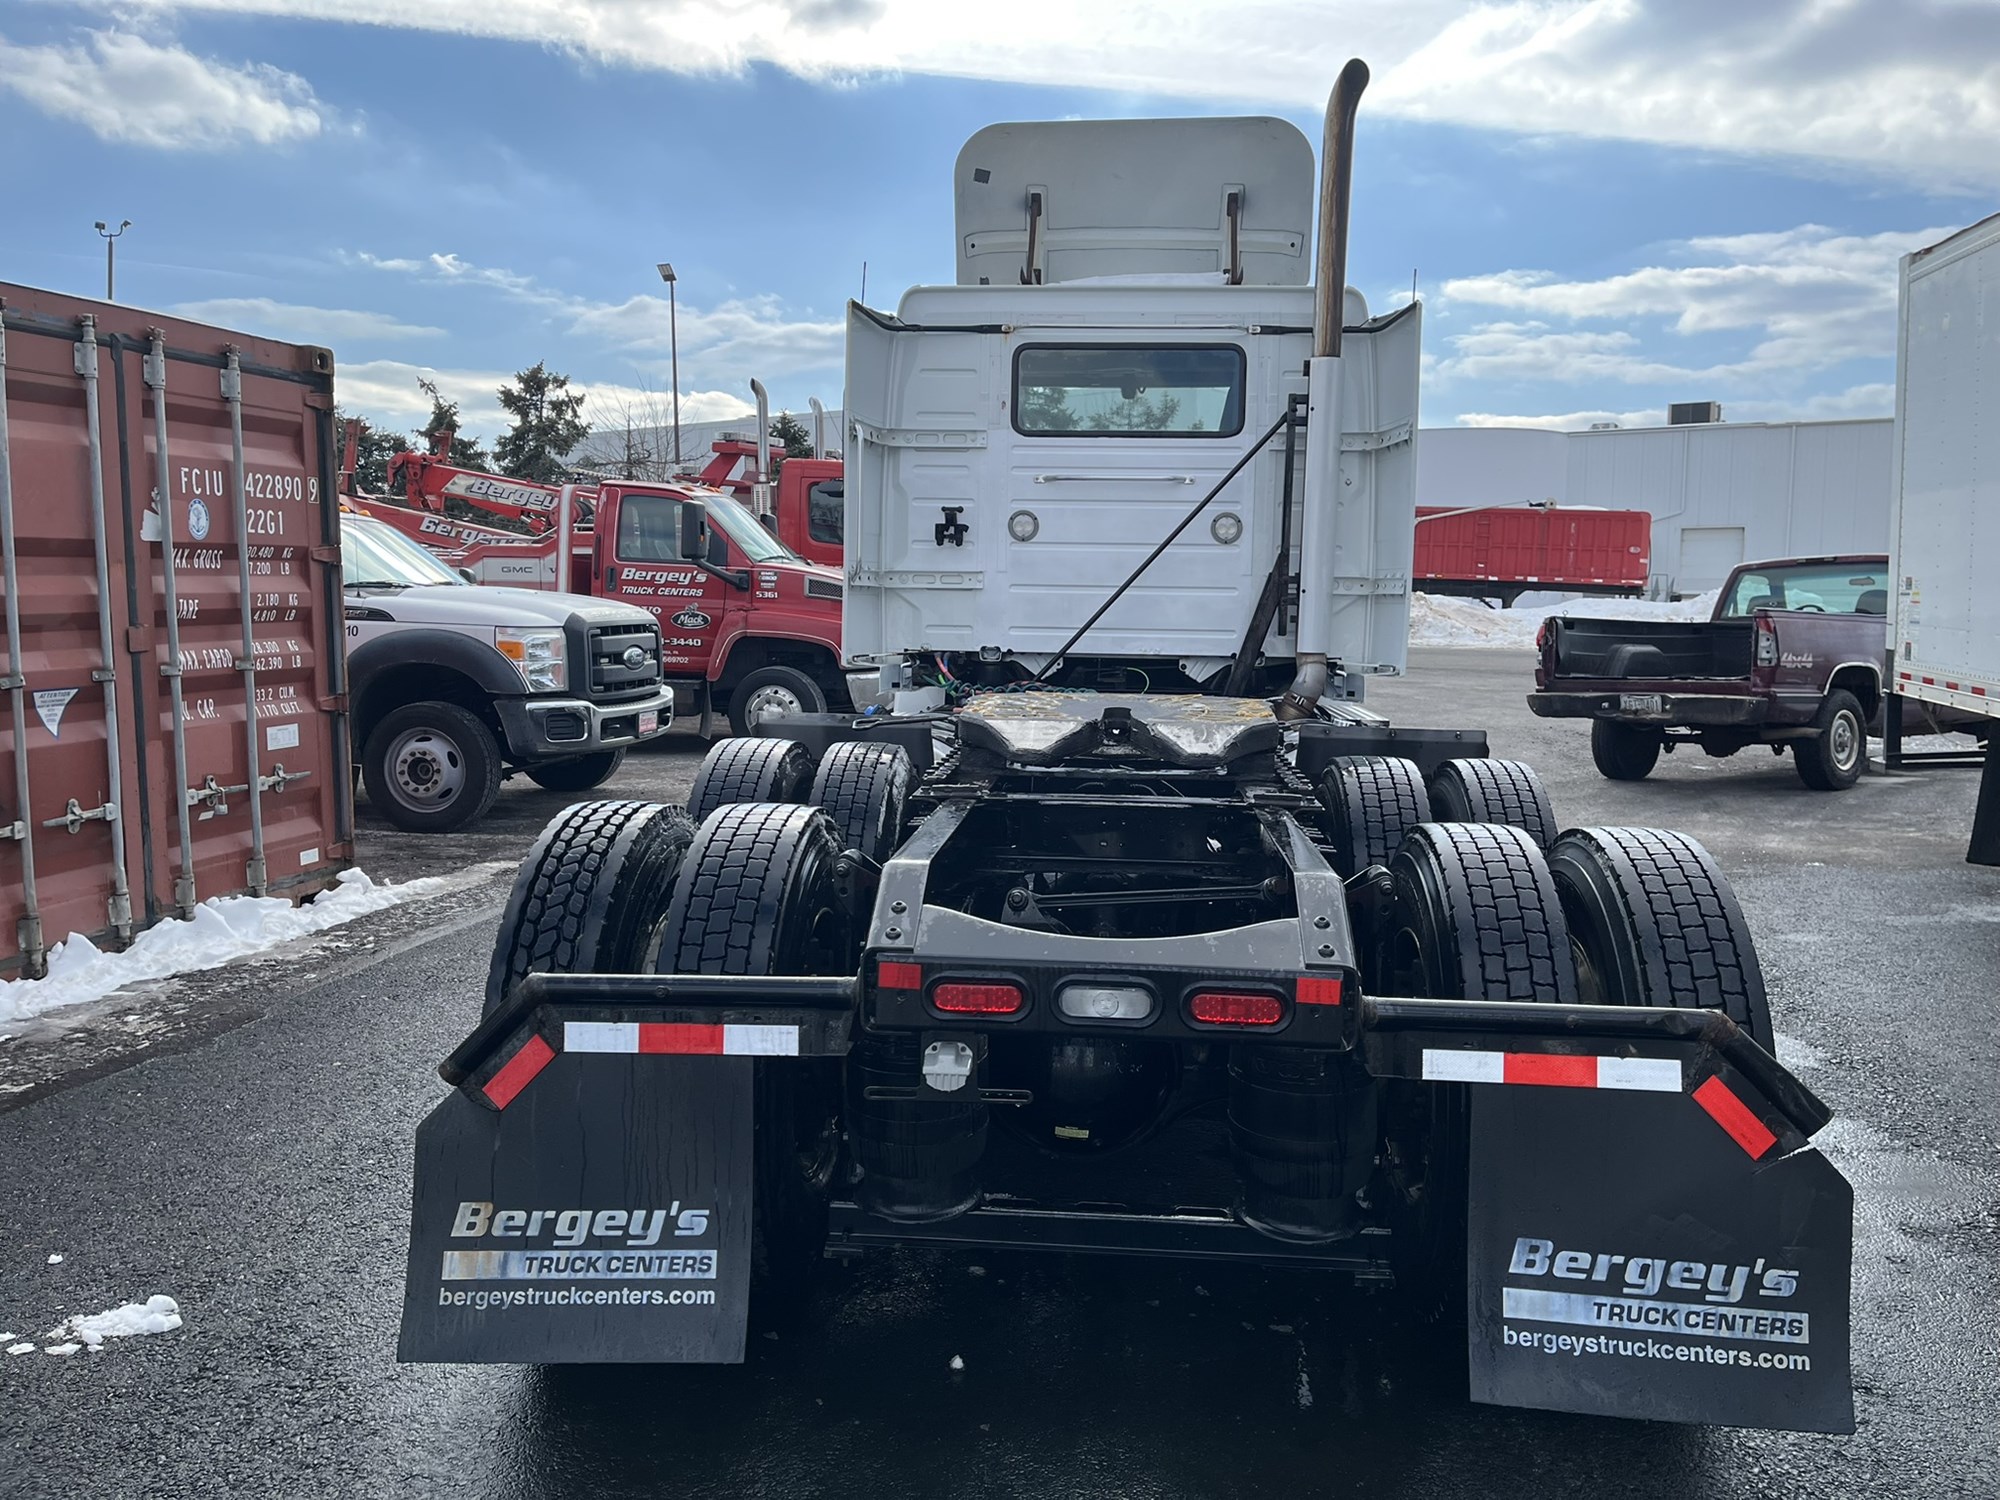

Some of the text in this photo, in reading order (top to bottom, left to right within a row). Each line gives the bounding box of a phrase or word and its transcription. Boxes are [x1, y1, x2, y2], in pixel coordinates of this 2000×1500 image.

[180, 467, 318, 502] FCIU 422890 9
[470, 479, 558, 510] Bergey
[247, 509, 284, 535] 22G1
[194, 550, 224, 569] GROSS
[282, 547, 294, 559] KG
[249, 562, 290, 575] 7.200 LB
[501, 566, 534, 574] GMC
[620, 567, 708, 585] Bergey's
[622, 586, 704, 597] TRUCK CENTERS
[178, 593, 298, 619] TARE 2.180 KG
[253, 610, 296, 622] 4.810 LB
[346, 625, 358, 637] 10
[677, 614, 705, 625] Mack
[202, 648, 233, 669] CARGO
[286, 640, 299, 652] KG
[256, 655, 302, 671] 62.390 LB
[196, 698, 220, 719] CAP.
[256, 688, 274, 702] 33.2
[450, 1200, 710, 1247] Bergey's
[524, 1255, 713, 1274] TRUCK CENTERS
[1508, 1237, 1800, 1304] Bergey's
[438, 1287, 716, 1310] bergeystruckcenters.com
[1592, 1302, 1804, 1338] TRUCK CENTERS
[1503, 1326, 1811, 1371] bergeystruckcenters.com
